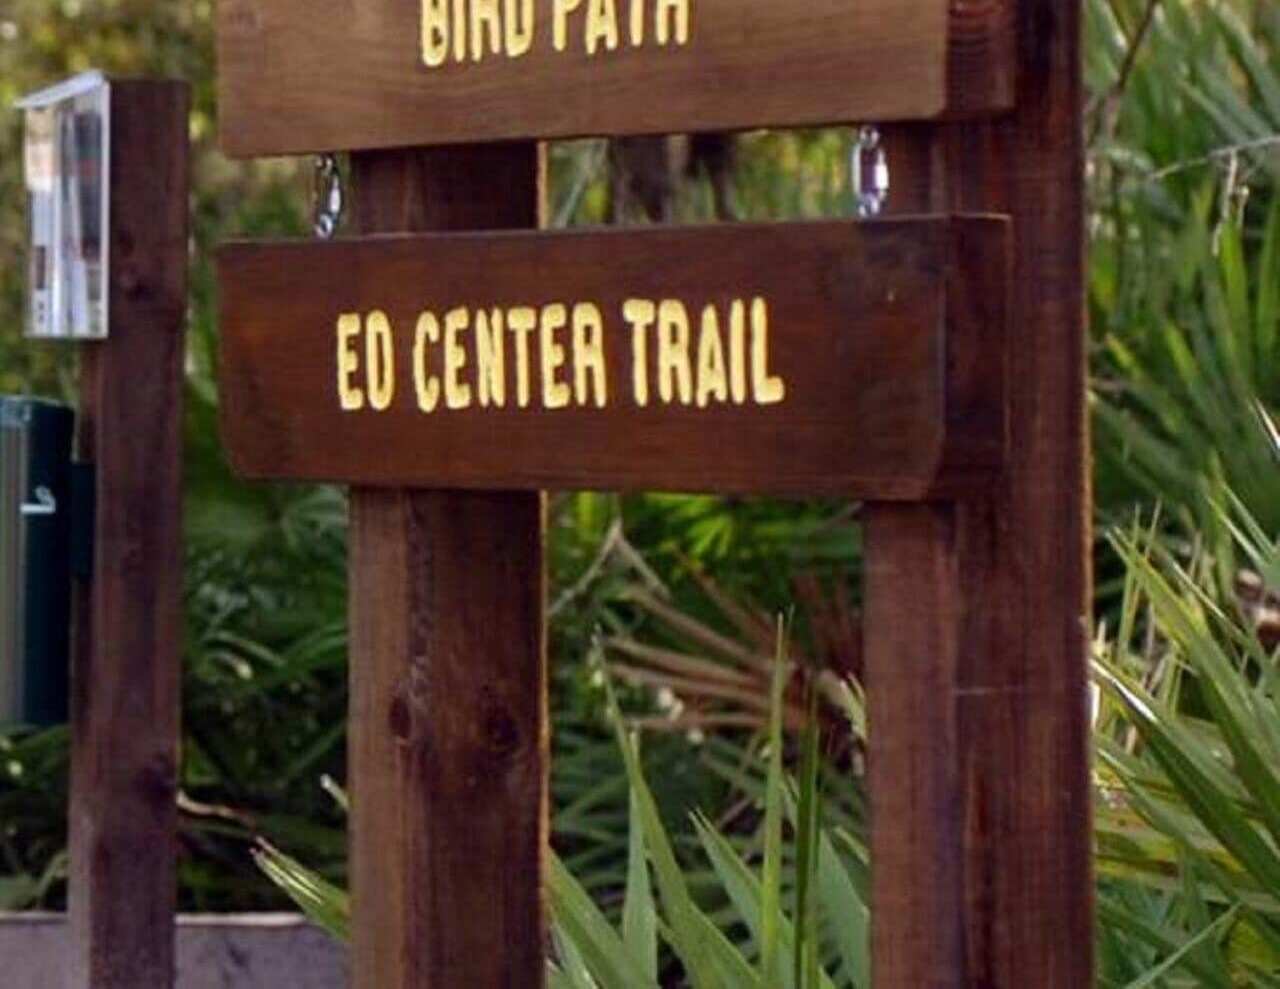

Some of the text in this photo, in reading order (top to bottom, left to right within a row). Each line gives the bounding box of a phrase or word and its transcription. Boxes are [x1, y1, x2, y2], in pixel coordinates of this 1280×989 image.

[336, 296, 785, 414] ED CENTER TRAIL
